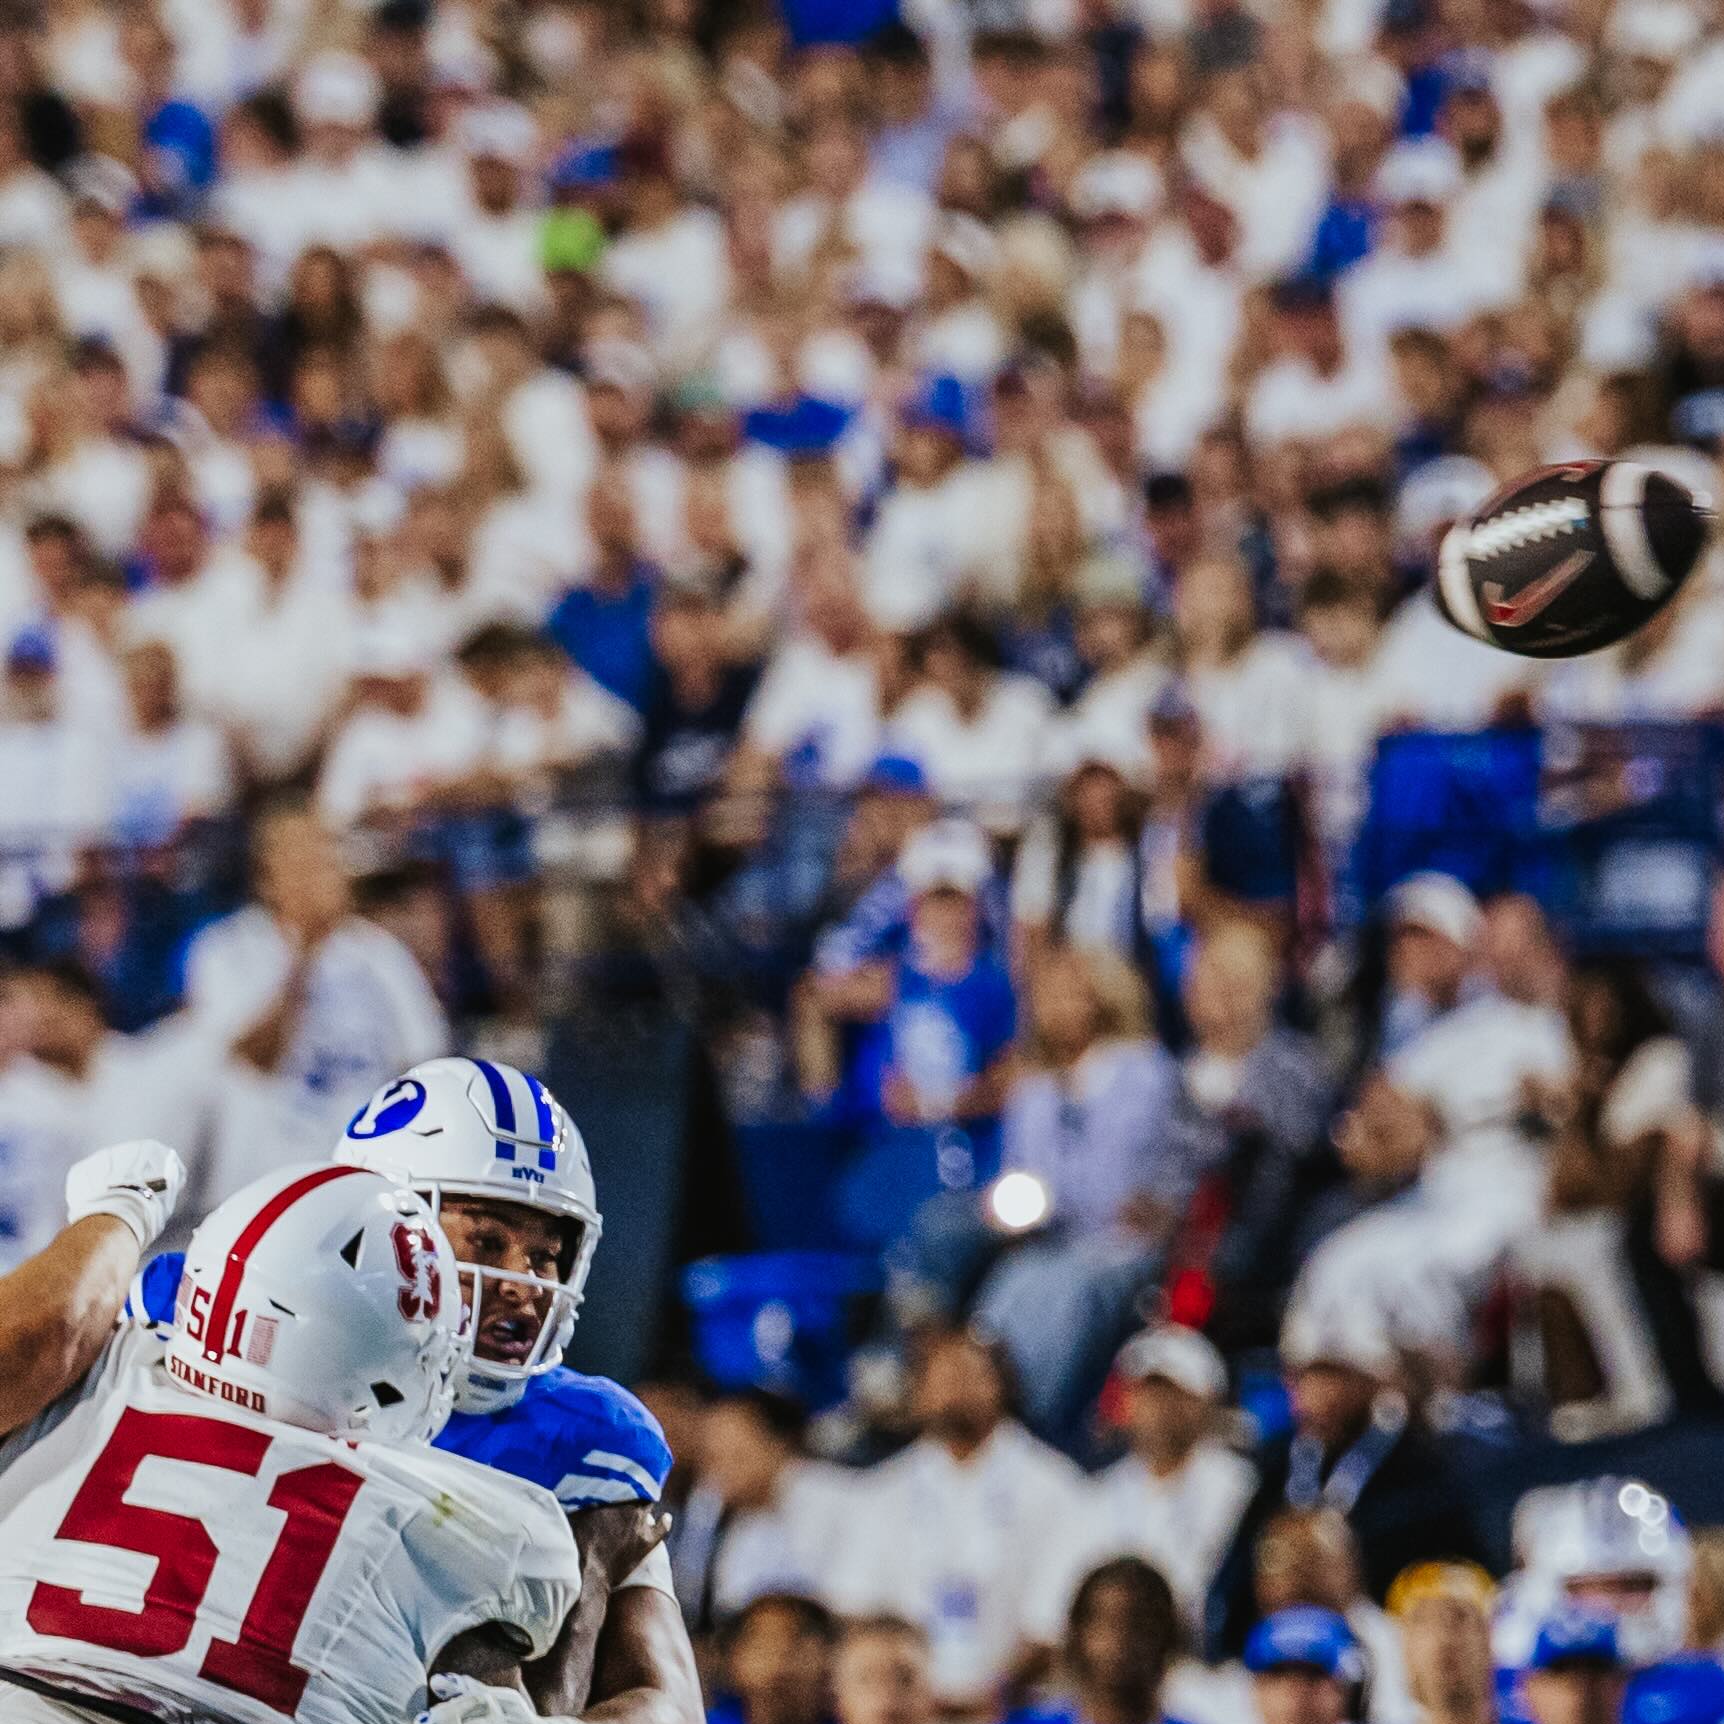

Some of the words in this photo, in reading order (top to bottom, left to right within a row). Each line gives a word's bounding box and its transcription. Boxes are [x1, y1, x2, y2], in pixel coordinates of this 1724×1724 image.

[186, 1285, 249, 1360] 51
[170, 1354, 267, 1414] STANFORD
[25, 1405, 367, 1719] 51
